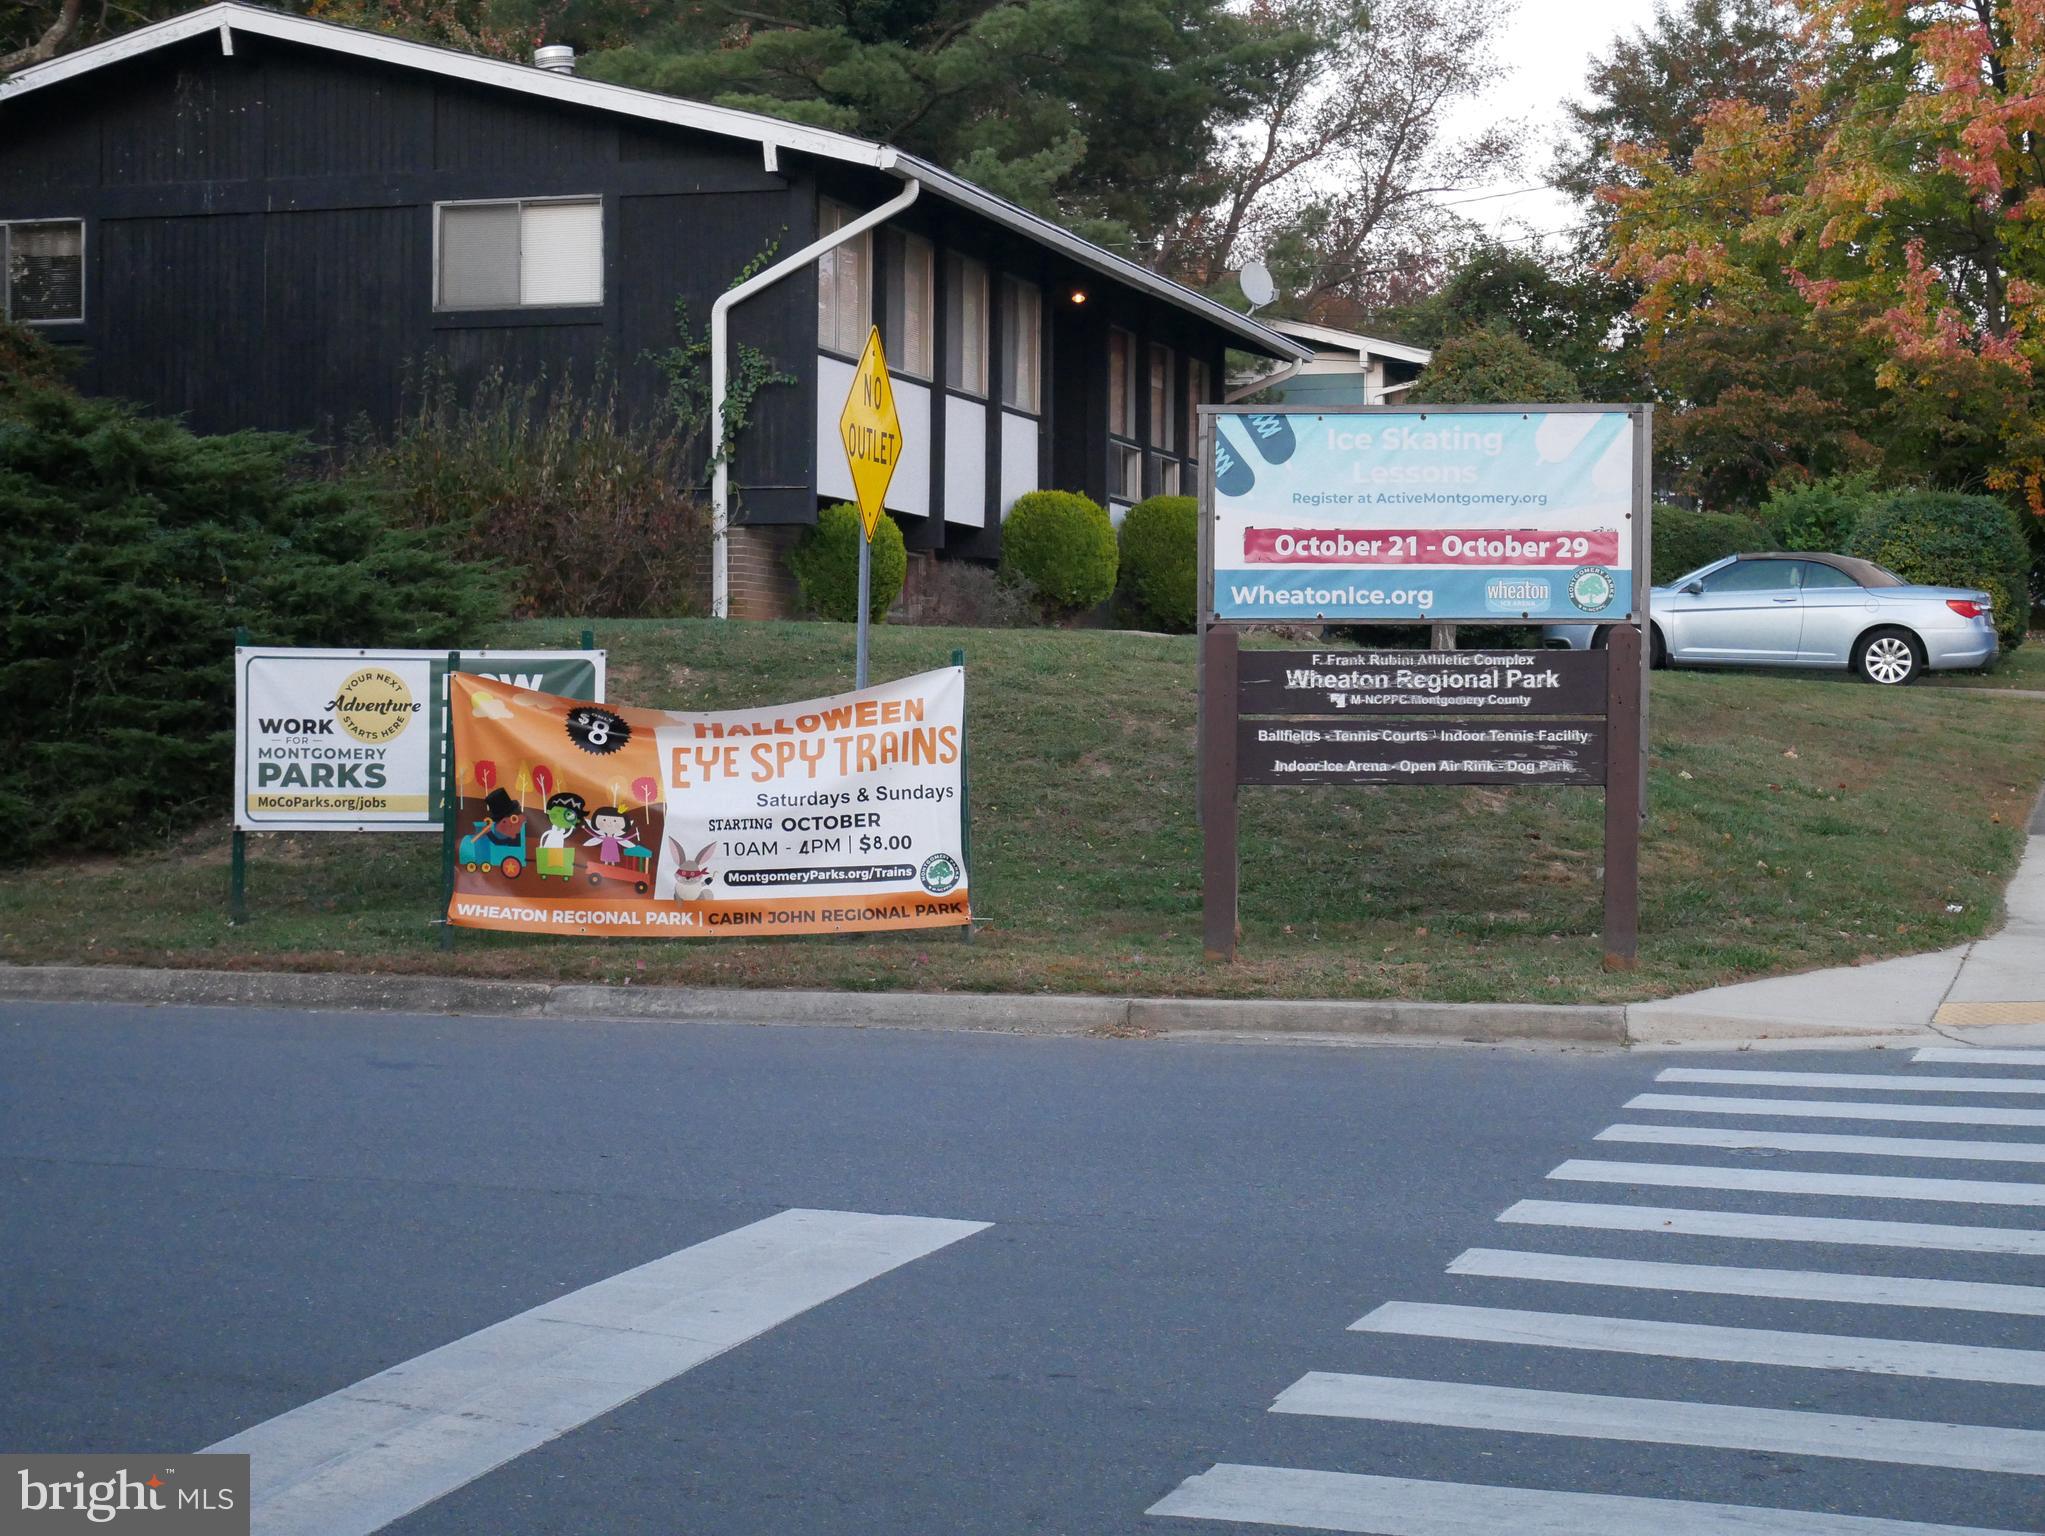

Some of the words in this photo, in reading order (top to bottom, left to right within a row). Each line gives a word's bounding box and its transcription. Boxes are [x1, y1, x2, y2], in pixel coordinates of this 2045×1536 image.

[864, 374, 882, 409] NO
[849, 423, 895, 466] OUTLET
[1327, 428, 1373, 450] Ice
[1381, 426, 1504, 456] Skating
[1353, 462, 1479, 484] Lessons
[1292, 492, 1353, 507] Register
[1358, 493, 1372, 504] at
[1376, 492, 1548, 506] ActiveMontgomery.org
[1275, 534, 1381, 557] October
[1388, 535, 1417, 556] 21
[1442, 535, 1550, 559] October
[1556, 536, 1589, 558] 29
[1231, 585, 1434, 609] WheatonIce.org
[1487, 580, 1548, 599] wheaton
[1327, 654, 1365, 665] Frank
[1418, 654, 1470, 665] Athletic
[1474, 654, 1535, 668] Complex
[345, 673, 373, 692] YOUR
[376, 673, 403, 693] NEXT
[1286, 669, 1388, 688] Wheaton
[1397, 669, 1499, 693] Regional
[1506, 669, 1560, 688] Park
[324, 694, 421, 715] Adventure
[1351, 695, 1407, 705] M-NCPPC
[1411, 695, 1485, 707] Montgomery
[1488, 695, 1531, 707] County
[258, 718, 334, 735] WORK
[343, 716, 378, 740] STARTS
[381, 716, 405, 738] HERE
[693, 698, 925, 740] HALLOWEEN
[1258, 730, 1321, 741] Ballfields
[1334, 730, 1378, 741] Tennis
[1382, 730, 1428, 741] Courts
[1441, 730, 1485, 741] Indoor
[1489, 730, 1534, 741] Tennis
[1539, 730, 1588, 744] Facility
[258, 748, 387, 760] MONTGOMERY
[671, 746, 740, 789] EYE
[750, 737, 826, 783] SPY
[833, 725, 958, 777] TRAINS
[258, 763, 387, 788] PARKS
[1275, 760, 1319, 771] Indoor
[1324, 760, 1343, 771] Ice
[1347, 760, 1387, 771] Arena
[1400, 760, 1435, 774] Open
[1439, 760, 1459, 771] Air
[1464, 760, 1493, 771] Rink
[1507, 760, 1535, 774] Dog
[1539, 760, 1570, 771] Park
[258, 796, 387, 811] MoCoParks.org/jobs
[756, 789, 851, 809] Saturdays
[856, 787, 870, 802] &
[875, 784, 954, 806] Sundays
[708, 818, 773, 832] STARTING
[781, 812, 881, 832] OCTOBER
[723, 840, 778, 857] 10AM
[798, 838, 841, 855] 4PM
[859, 834, 912, 854] $8.00
[727, 866, 913, 885] MontgomeryParks.org/Trains
[457, 903, 548, 923] WHEATON
[552, 910, 641, 925] REGIONAL
[646, 912, 693, 926] PARK
[708, 911, 763, 926] CABIN
[768, 909, 816, 924] JOHN
[821, 905, 911, 922] REGIONAL
[914, 902, 962, 918] PARK
